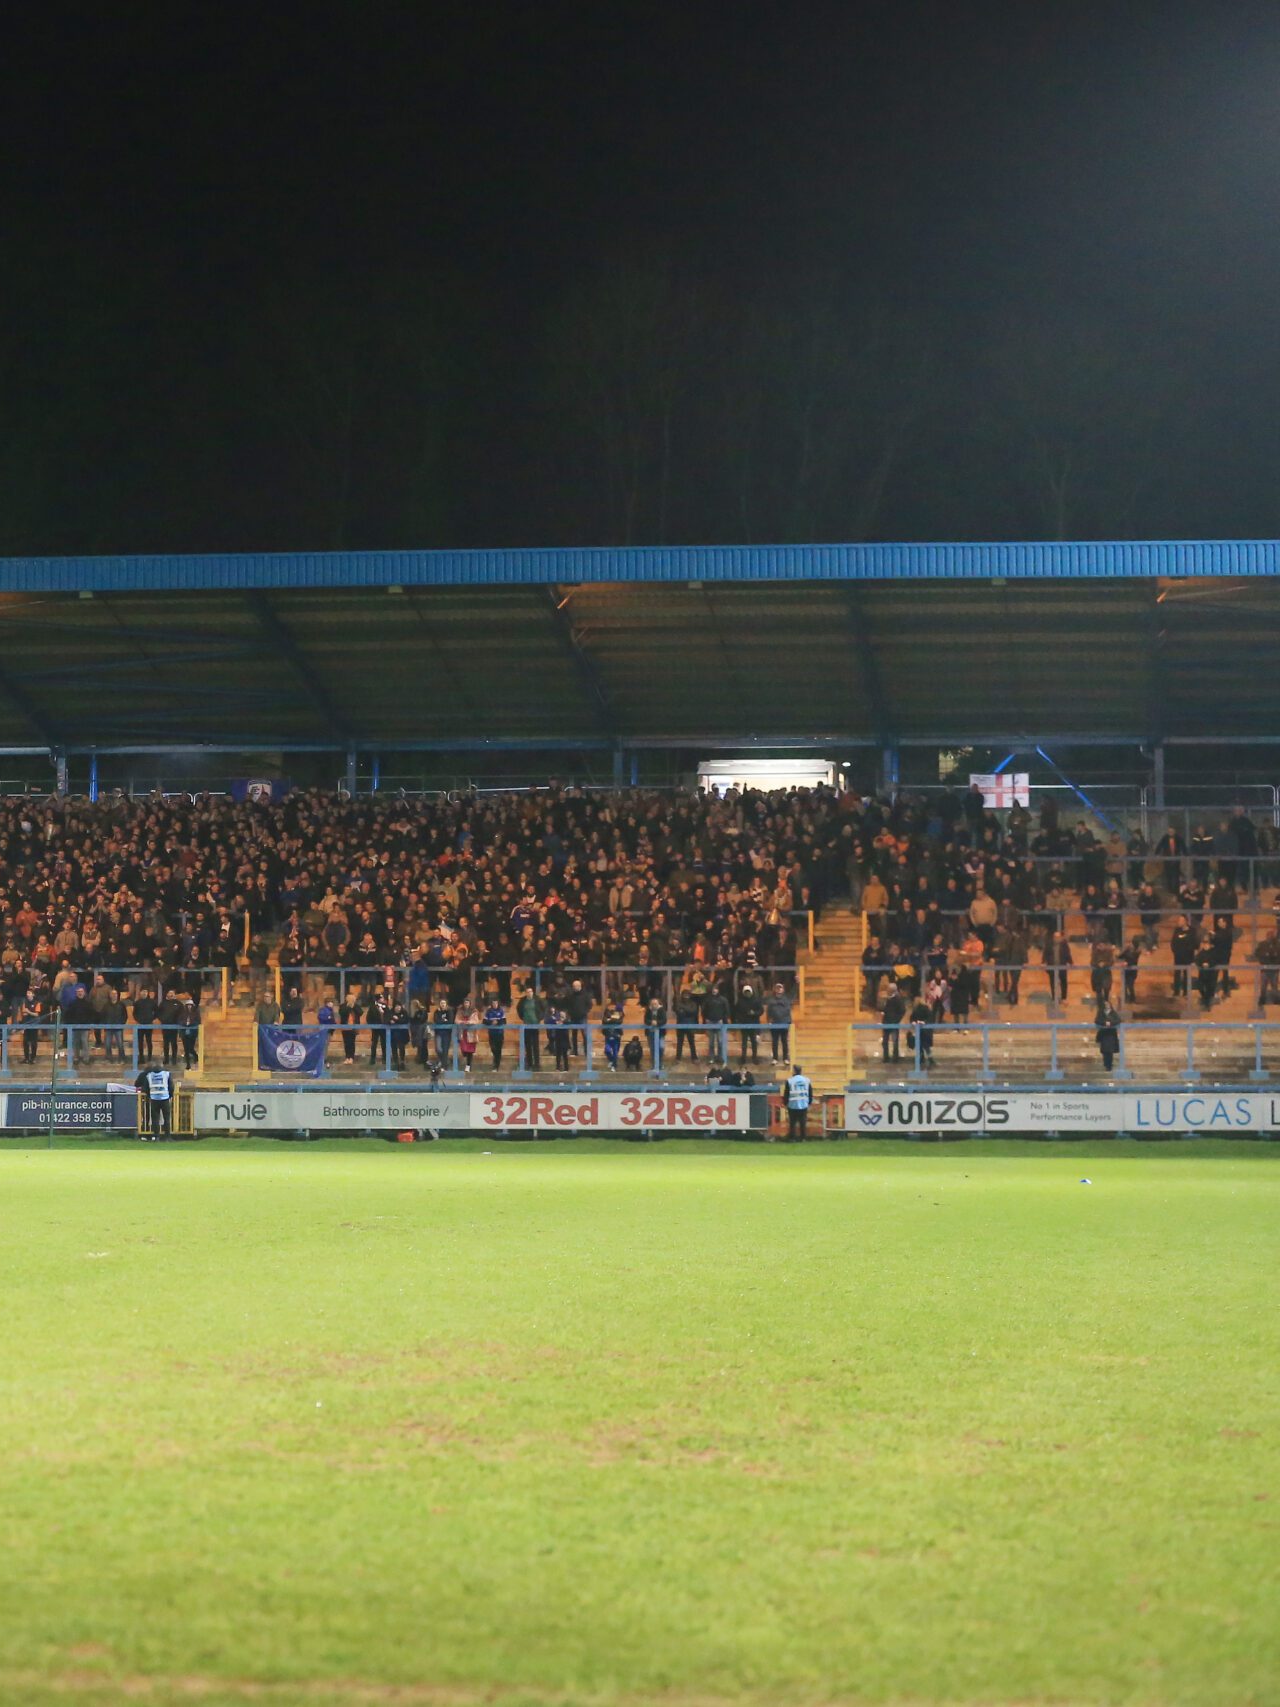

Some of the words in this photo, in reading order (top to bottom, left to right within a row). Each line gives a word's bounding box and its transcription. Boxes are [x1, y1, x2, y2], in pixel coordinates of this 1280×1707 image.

[214, 1098, 267, 1121] nuie
[323, 1106, 385, 1117] Bathrooms
[388, 1107, 400, 1117] to
[403, 1106, 440, 1119] inspire
[483, 1097, 599, 1125] 32Red
[620, 1097, 736, 1125] 32Red
[888, 1100, 1009, 1125] MIZOS
[1030, 1102, 1042, 1110] No
[1053, 1102, 1061, 1110] in
[1063, 1102, 1089, 1111] Sports
[1137, 1098, 1252, 1126] LUCAS
[73, 1113, 91, 1123] 358
[94, 1113, 112, 1123] 525
[1030, 1113, 1083, 1121] Performance
[1085, 1113, 1111, 1122] Layers
